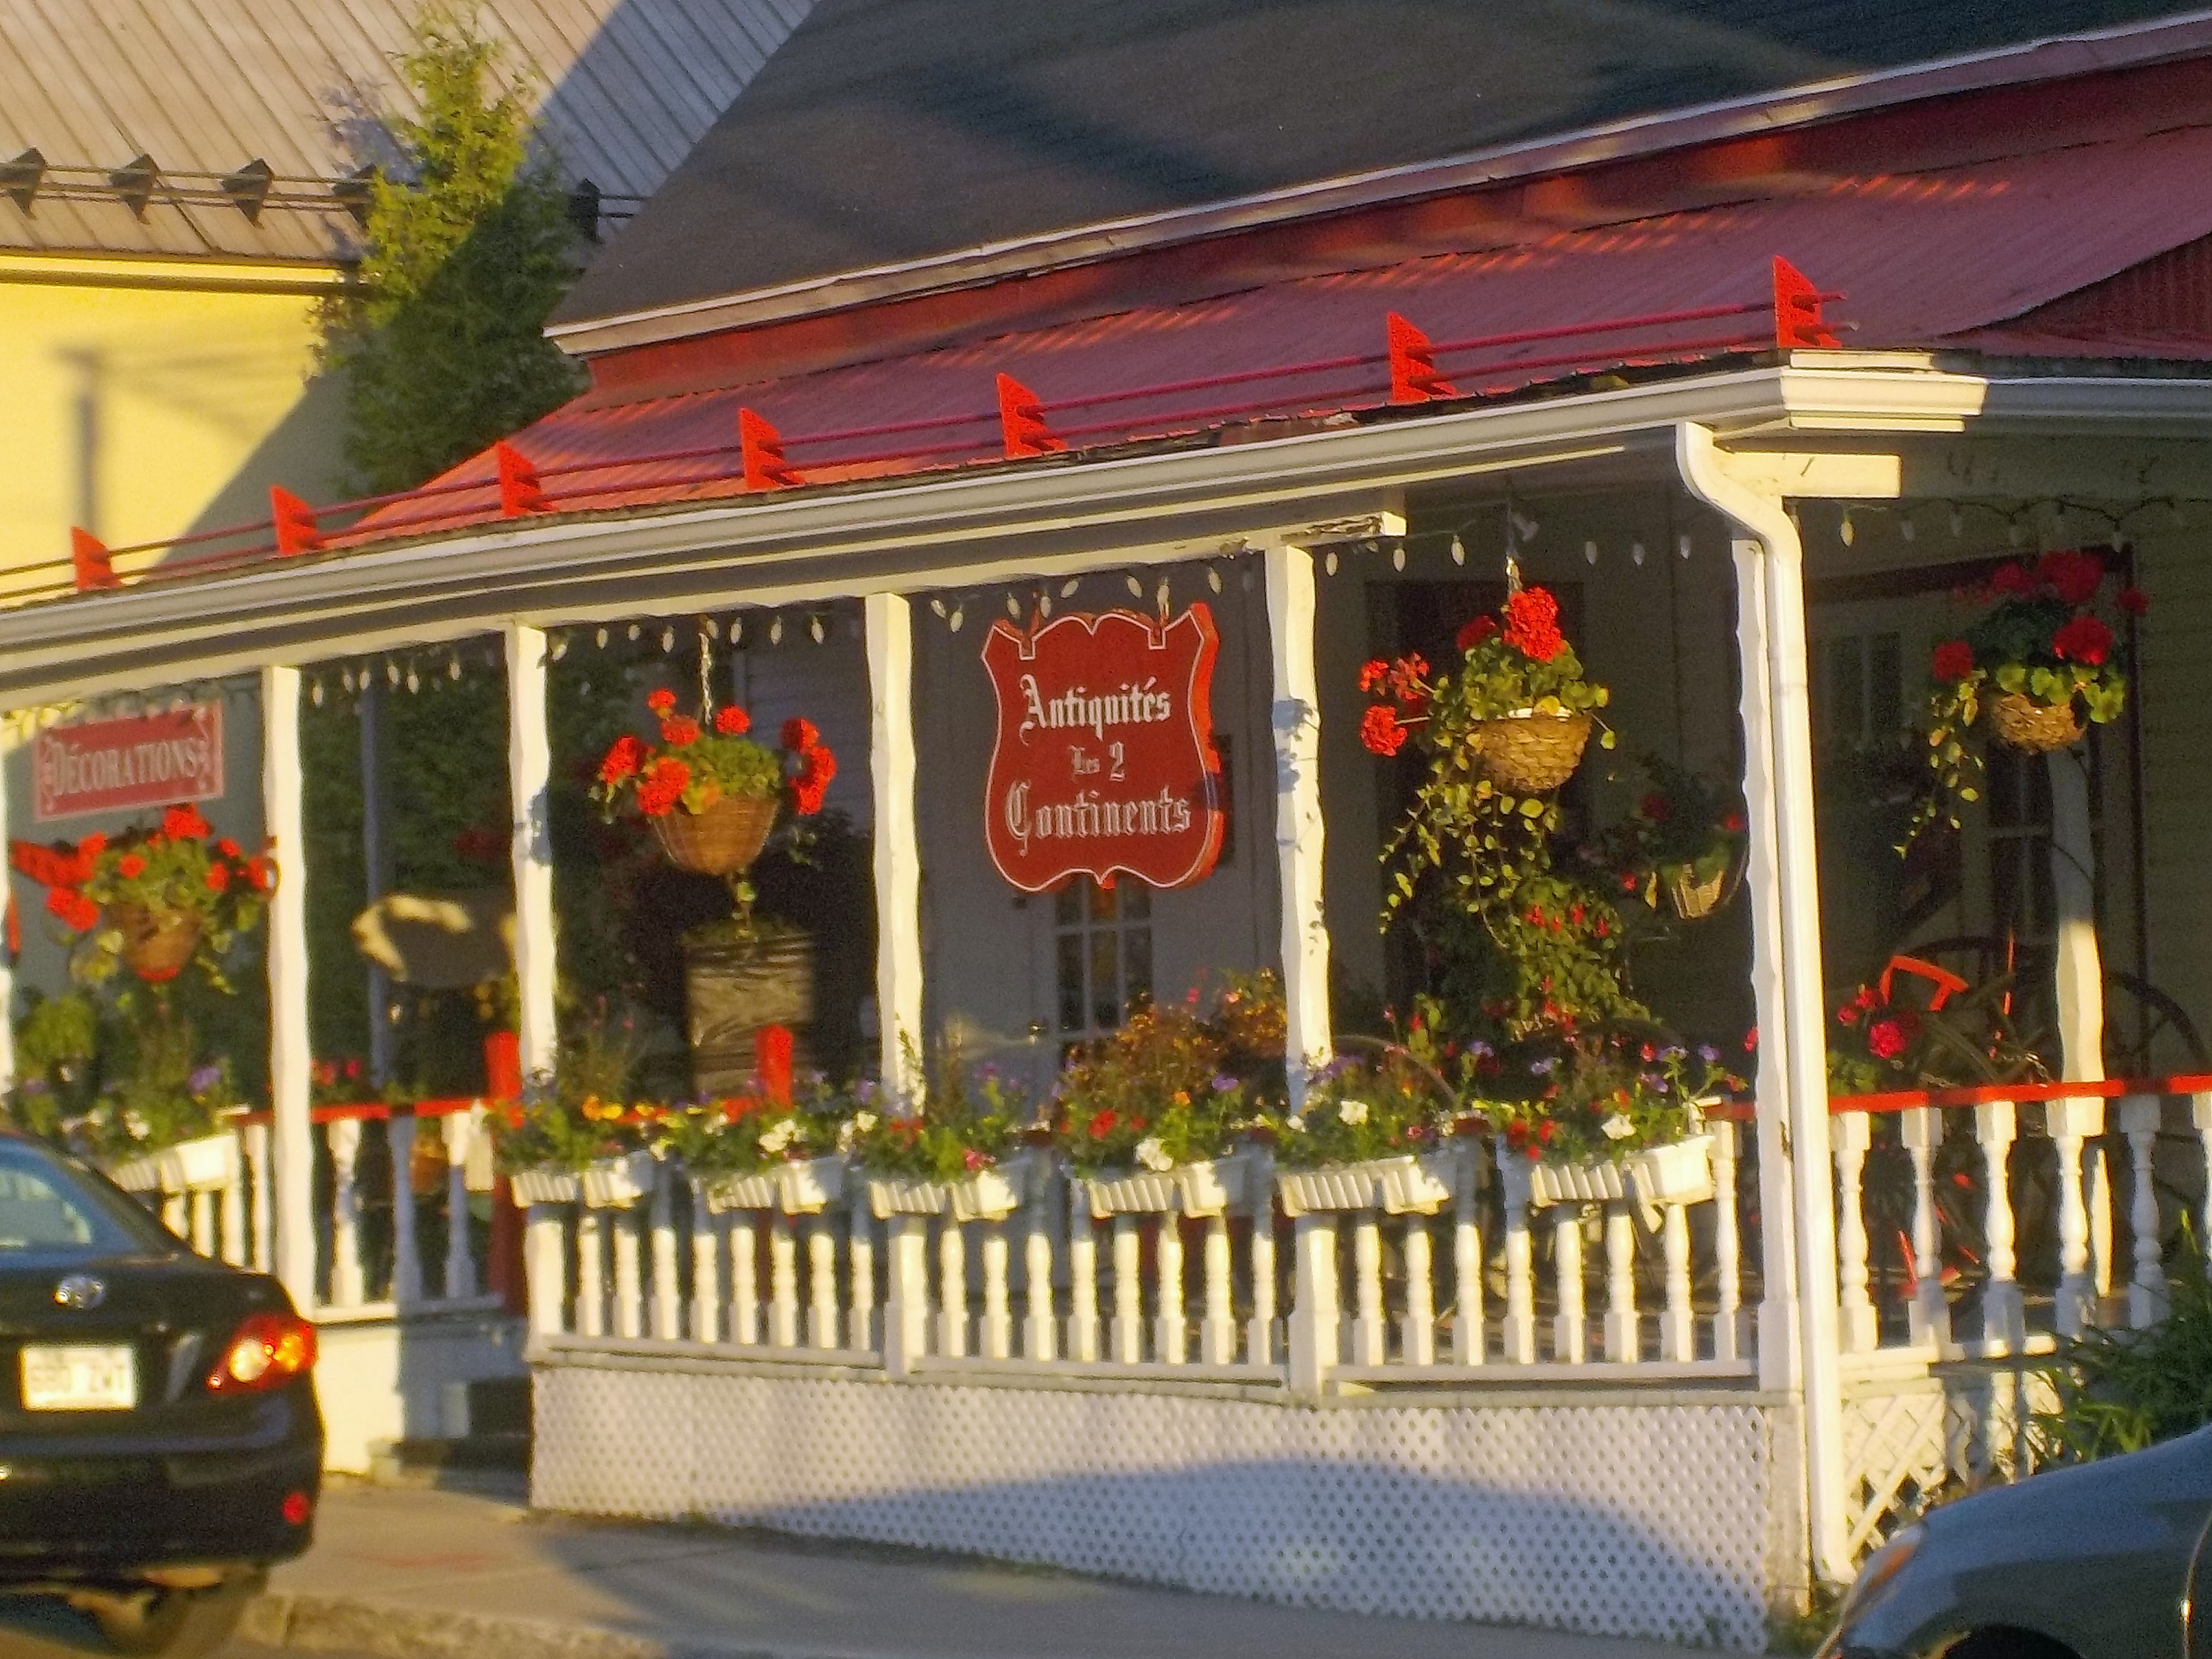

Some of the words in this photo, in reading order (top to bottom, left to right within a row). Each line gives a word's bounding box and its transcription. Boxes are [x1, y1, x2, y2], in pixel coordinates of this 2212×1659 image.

[1019, 674, 1171, 745] Antiquités
[1109, 741, 1126, 782] 2
[1006, 780, 1191, 857] Continents
